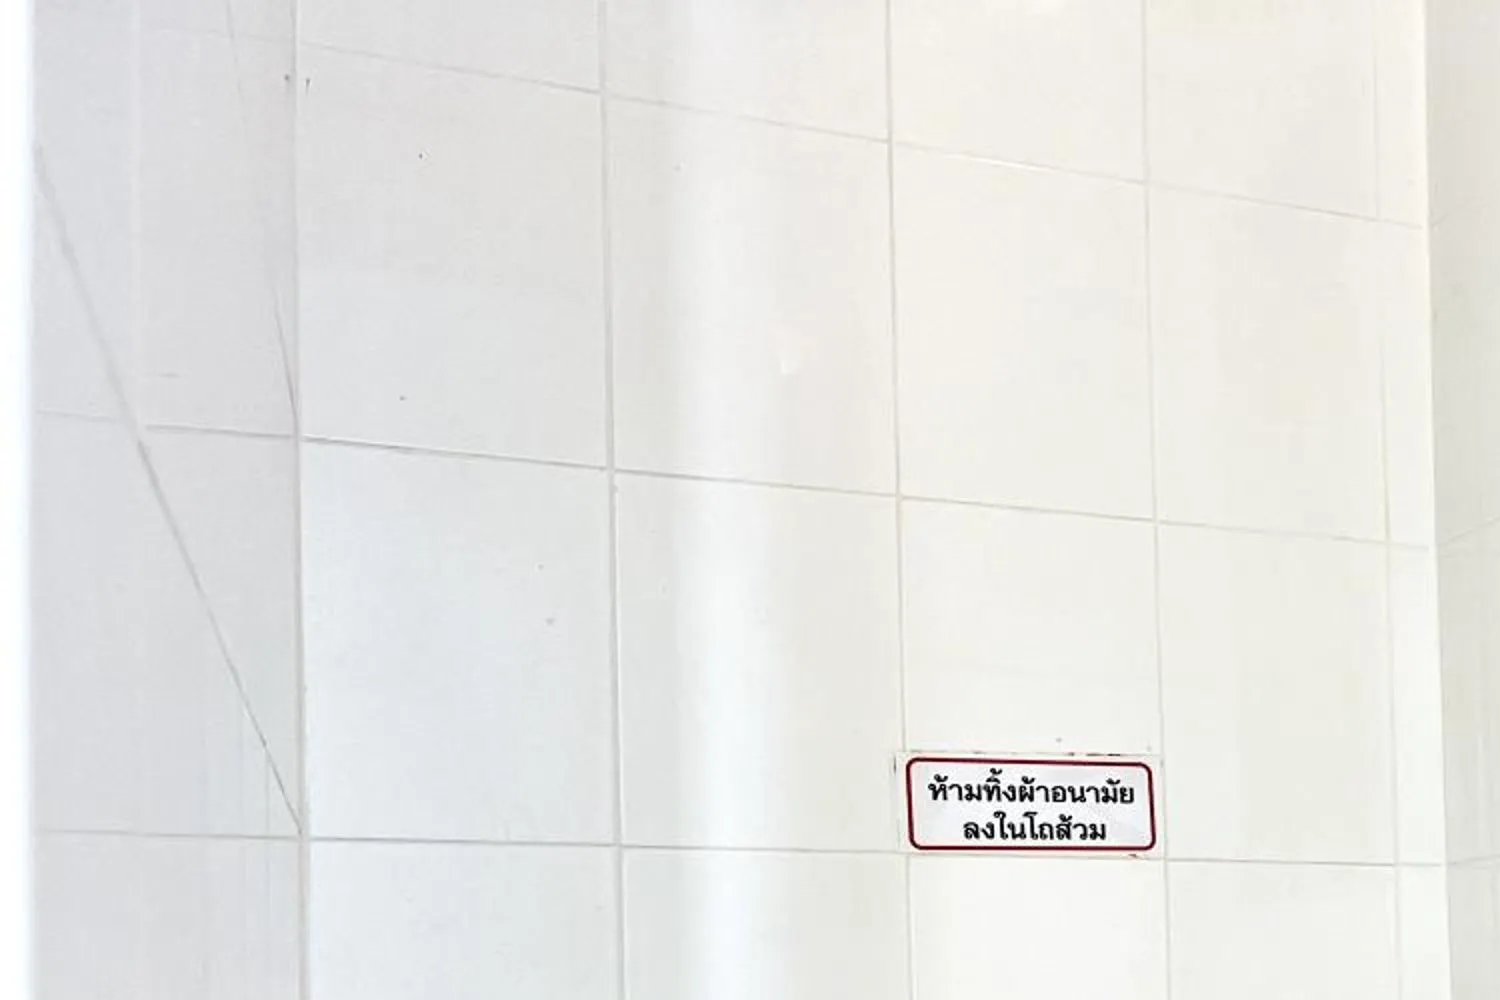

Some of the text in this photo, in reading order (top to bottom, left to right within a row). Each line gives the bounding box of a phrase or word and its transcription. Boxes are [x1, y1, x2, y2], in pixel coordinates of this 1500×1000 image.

[927, 767, 1135, 804] ห้ามทิ้งผ้าอนามัย
[963, 811, 1107, 841] ลงในโถส้วม
